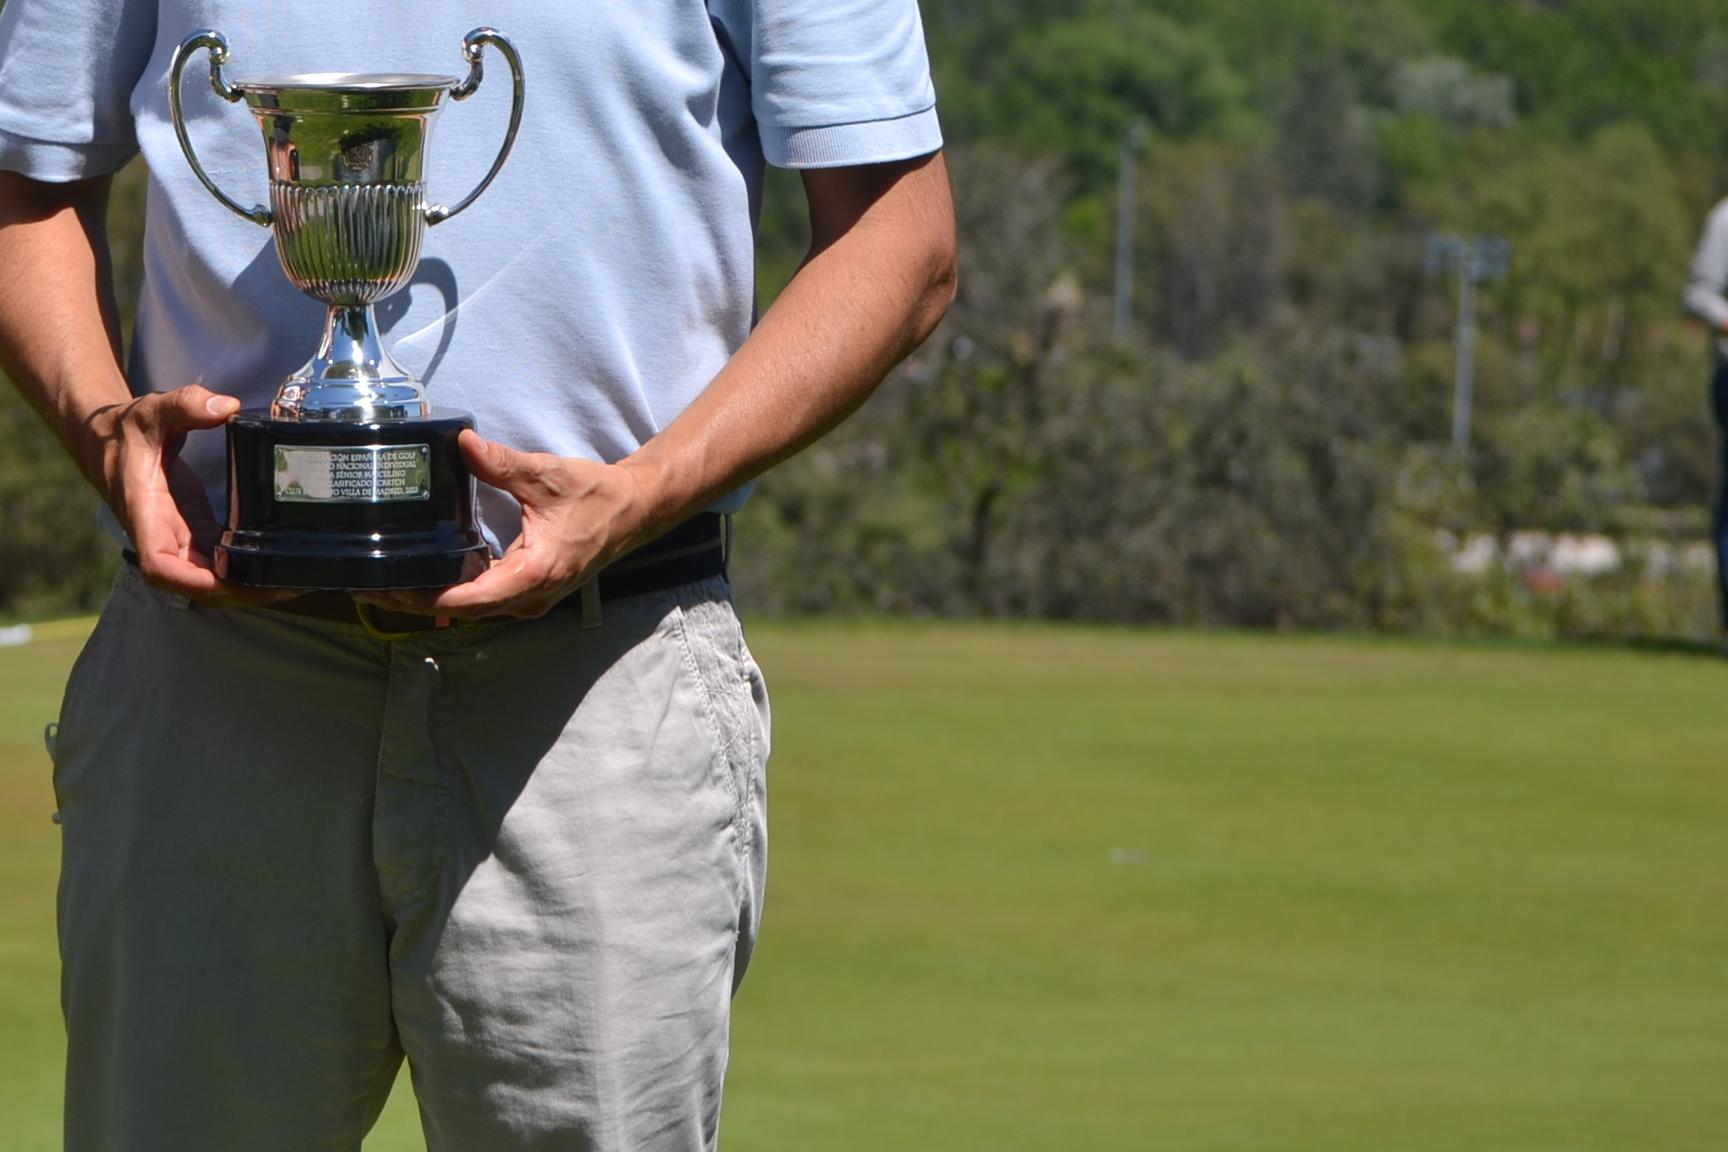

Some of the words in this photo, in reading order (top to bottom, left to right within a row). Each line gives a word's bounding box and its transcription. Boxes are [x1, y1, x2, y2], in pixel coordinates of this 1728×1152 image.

[351, 452, 386, 462] ESPAÑLA
[387, 452, 397, 461] DE
[398, 451, 416, 460] GOLF
[341, 487, 361, 496] VILLA
[362, 487, 372, 496] DE
